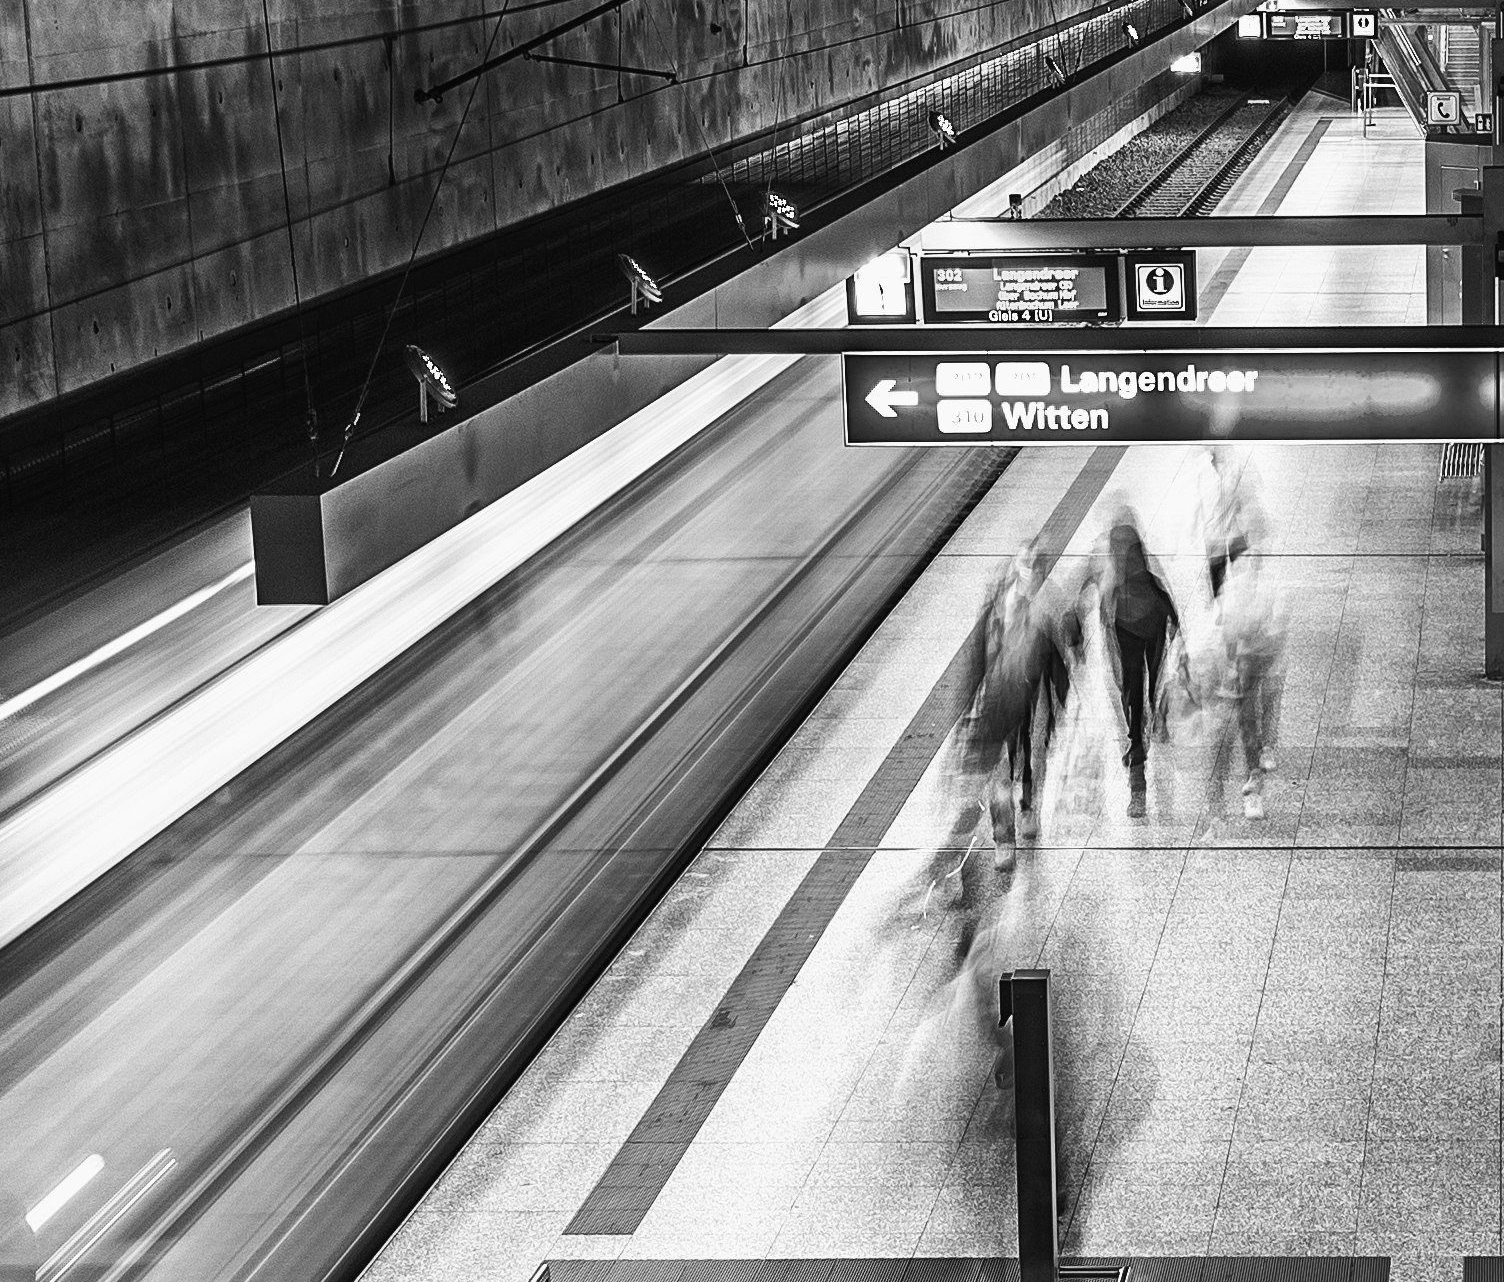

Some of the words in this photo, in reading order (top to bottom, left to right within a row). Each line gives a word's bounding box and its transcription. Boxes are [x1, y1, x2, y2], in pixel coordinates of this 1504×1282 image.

[937, 269, 963, 282] 302
[993, 268, 1078, 283] Langendreer
[989, 310, 1019, 322] Gleis
[1021, 310, 1031, 321] 4
[1060, 364, 1258, 399] Langendreer
[1001, 401, 1109, 430] Witten
